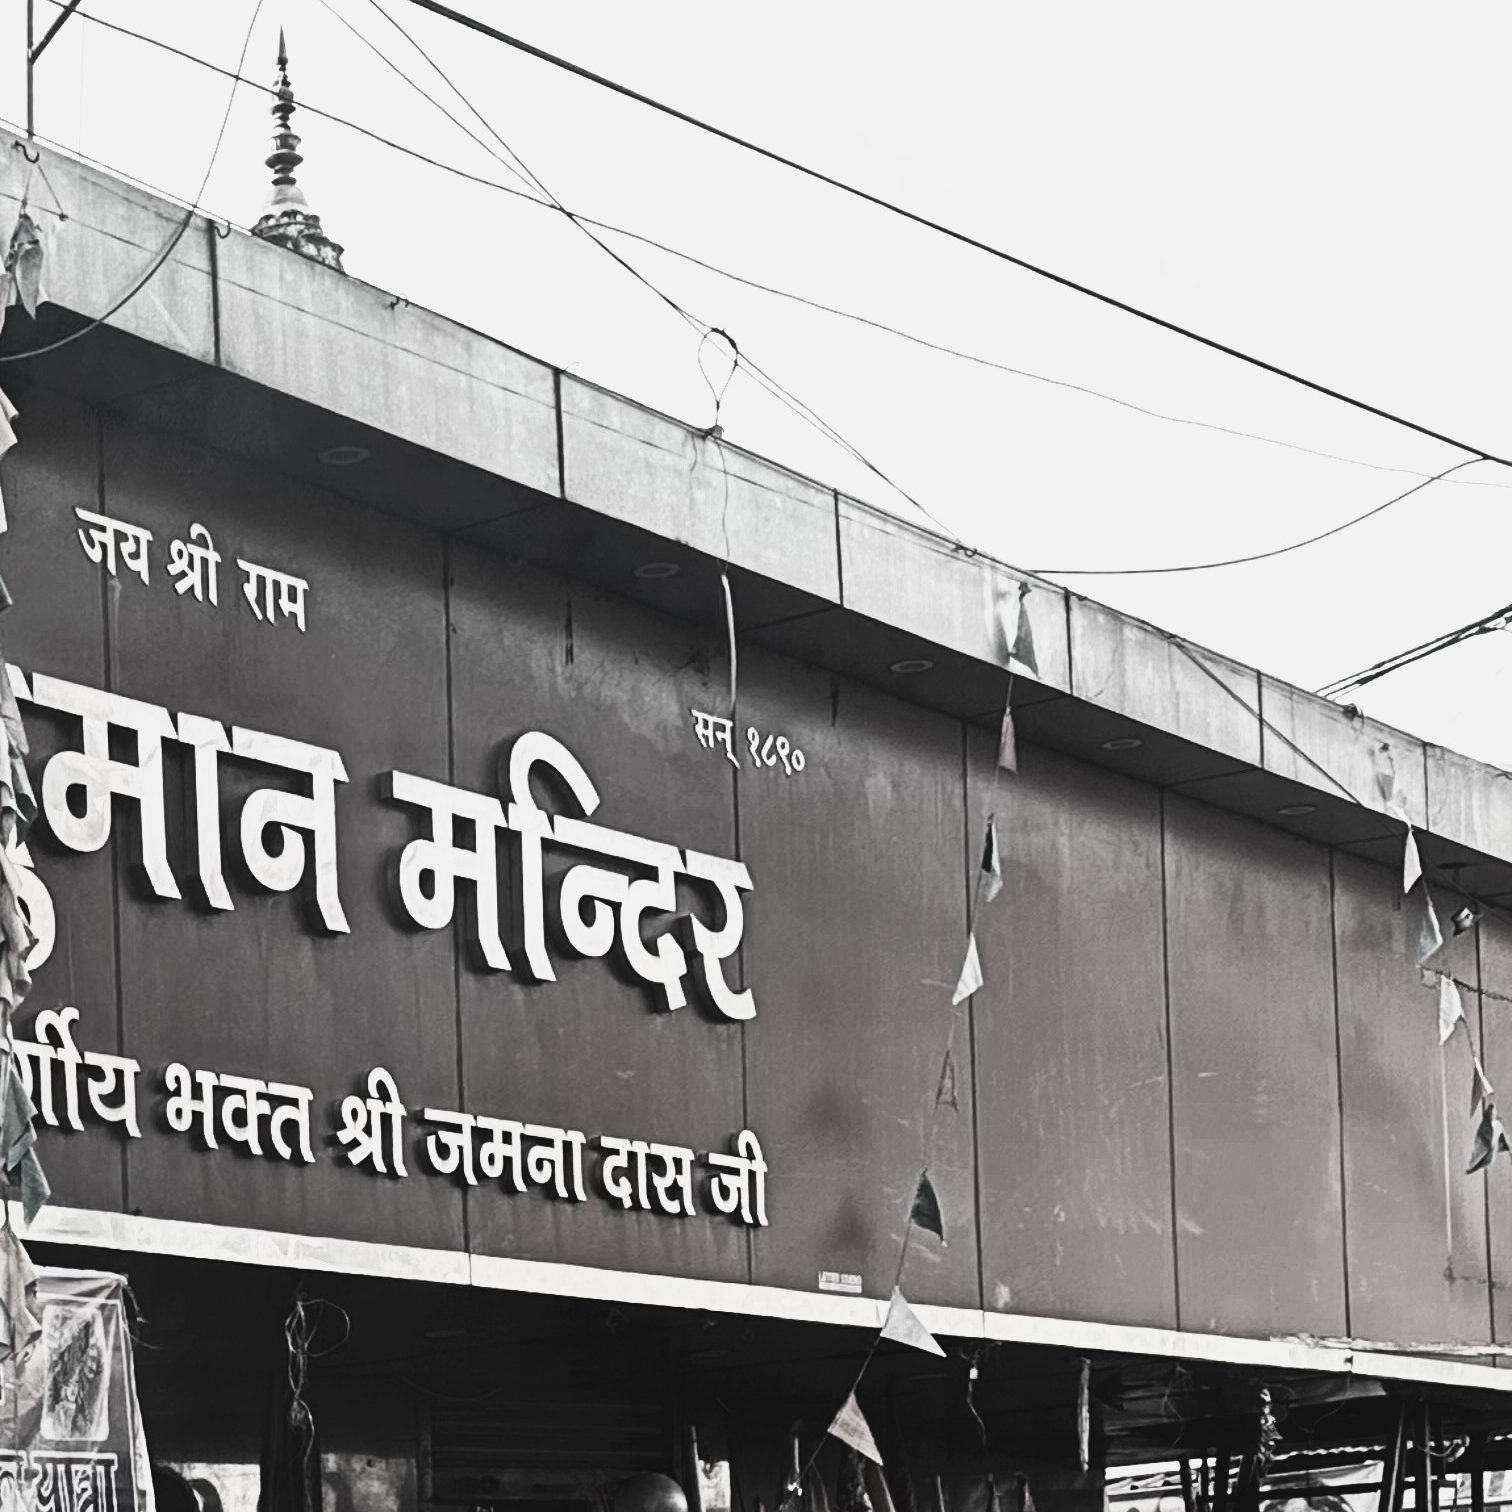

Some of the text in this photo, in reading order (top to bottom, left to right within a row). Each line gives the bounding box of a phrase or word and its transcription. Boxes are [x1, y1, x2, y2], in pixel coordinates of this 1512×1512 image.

[74, 507, 308, 631] जय श्री राम
[690, 709, 806, 775] सन् १८९०
[392, 731, 756, 1021] मन्दिर
[165, 1062, 314, 1163] भक्त
[337, 1067, 407, 1177] श्री
[424, 1107, 588, 1202] जमना
[600, 1136, 696, 1216] दास
[707, 1129, 769, 1227] जी
